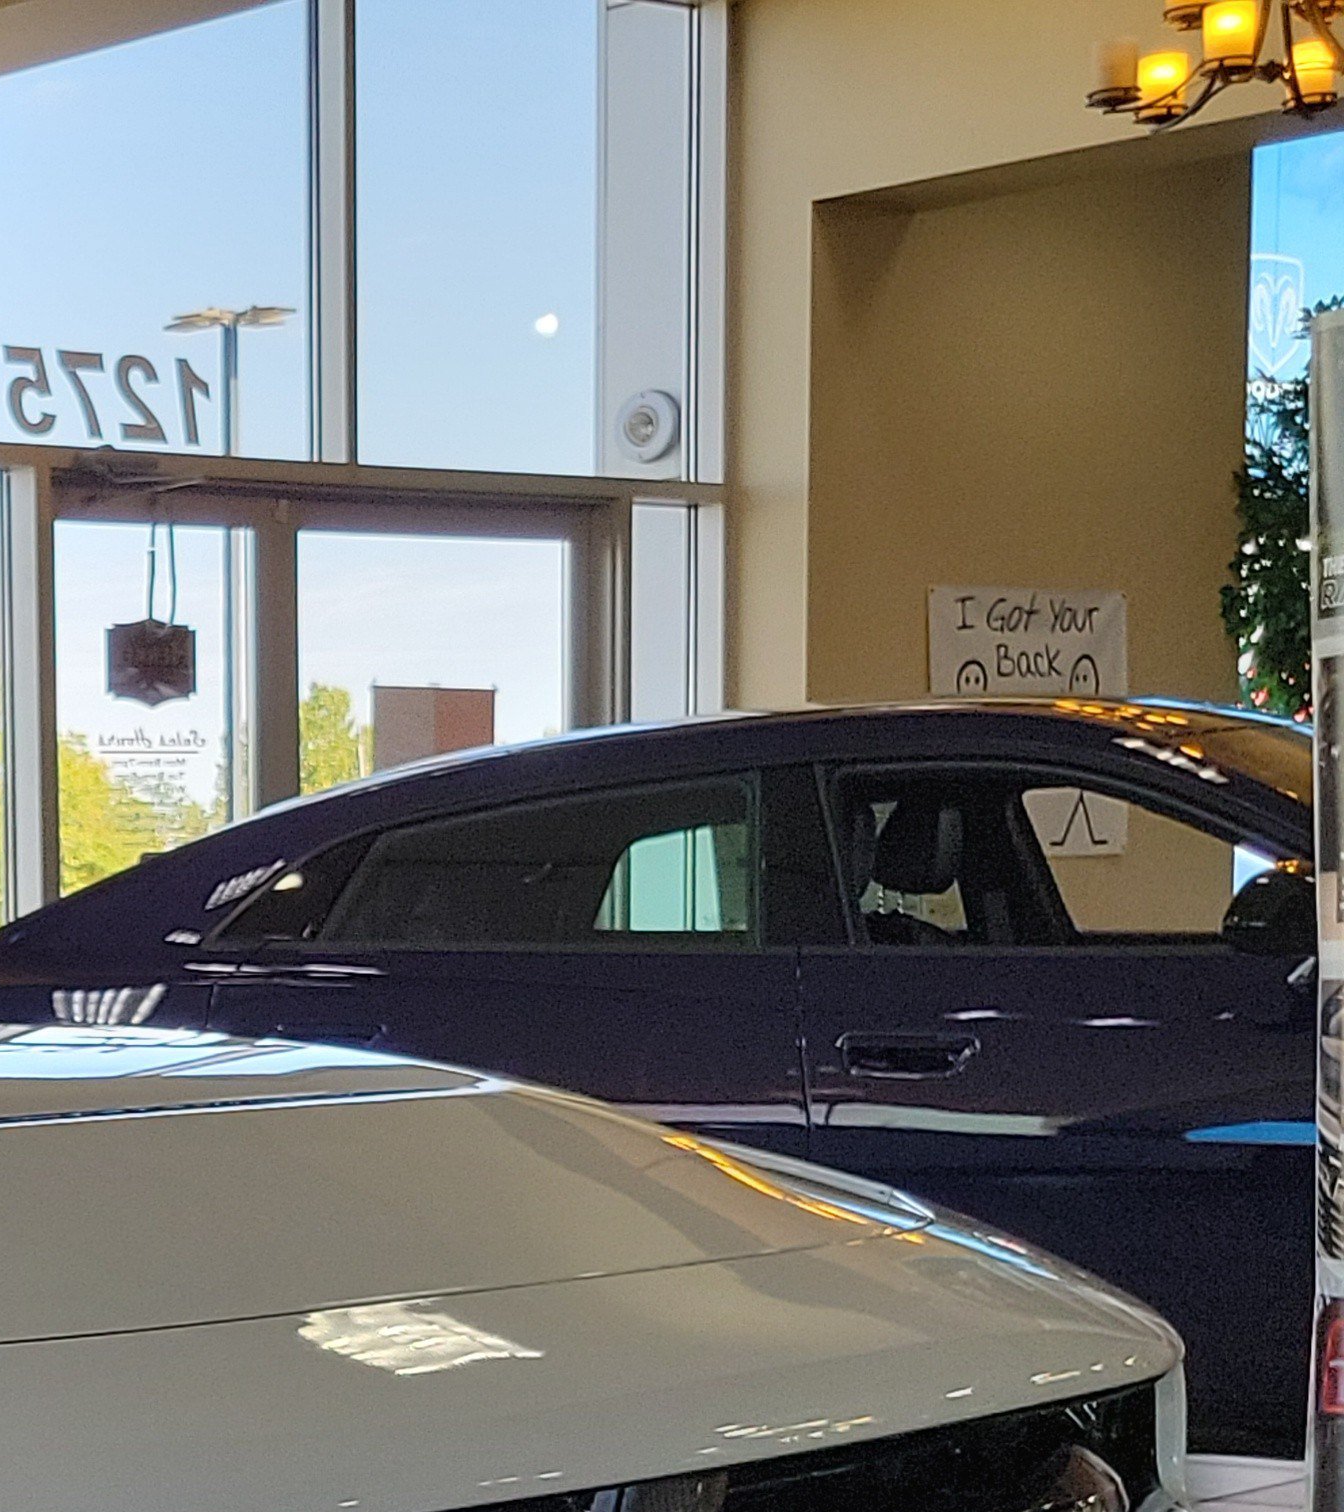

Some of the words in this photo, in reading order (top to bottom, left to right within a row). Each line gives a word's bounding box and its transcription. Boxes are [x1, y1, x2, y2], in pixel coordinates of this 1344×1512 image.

[955, 596, 976, 630] I
[986, 592, 1040, 633] Got
[1049, 598, 1099, 633] Your
[996, 643, 1061, 678] Back
